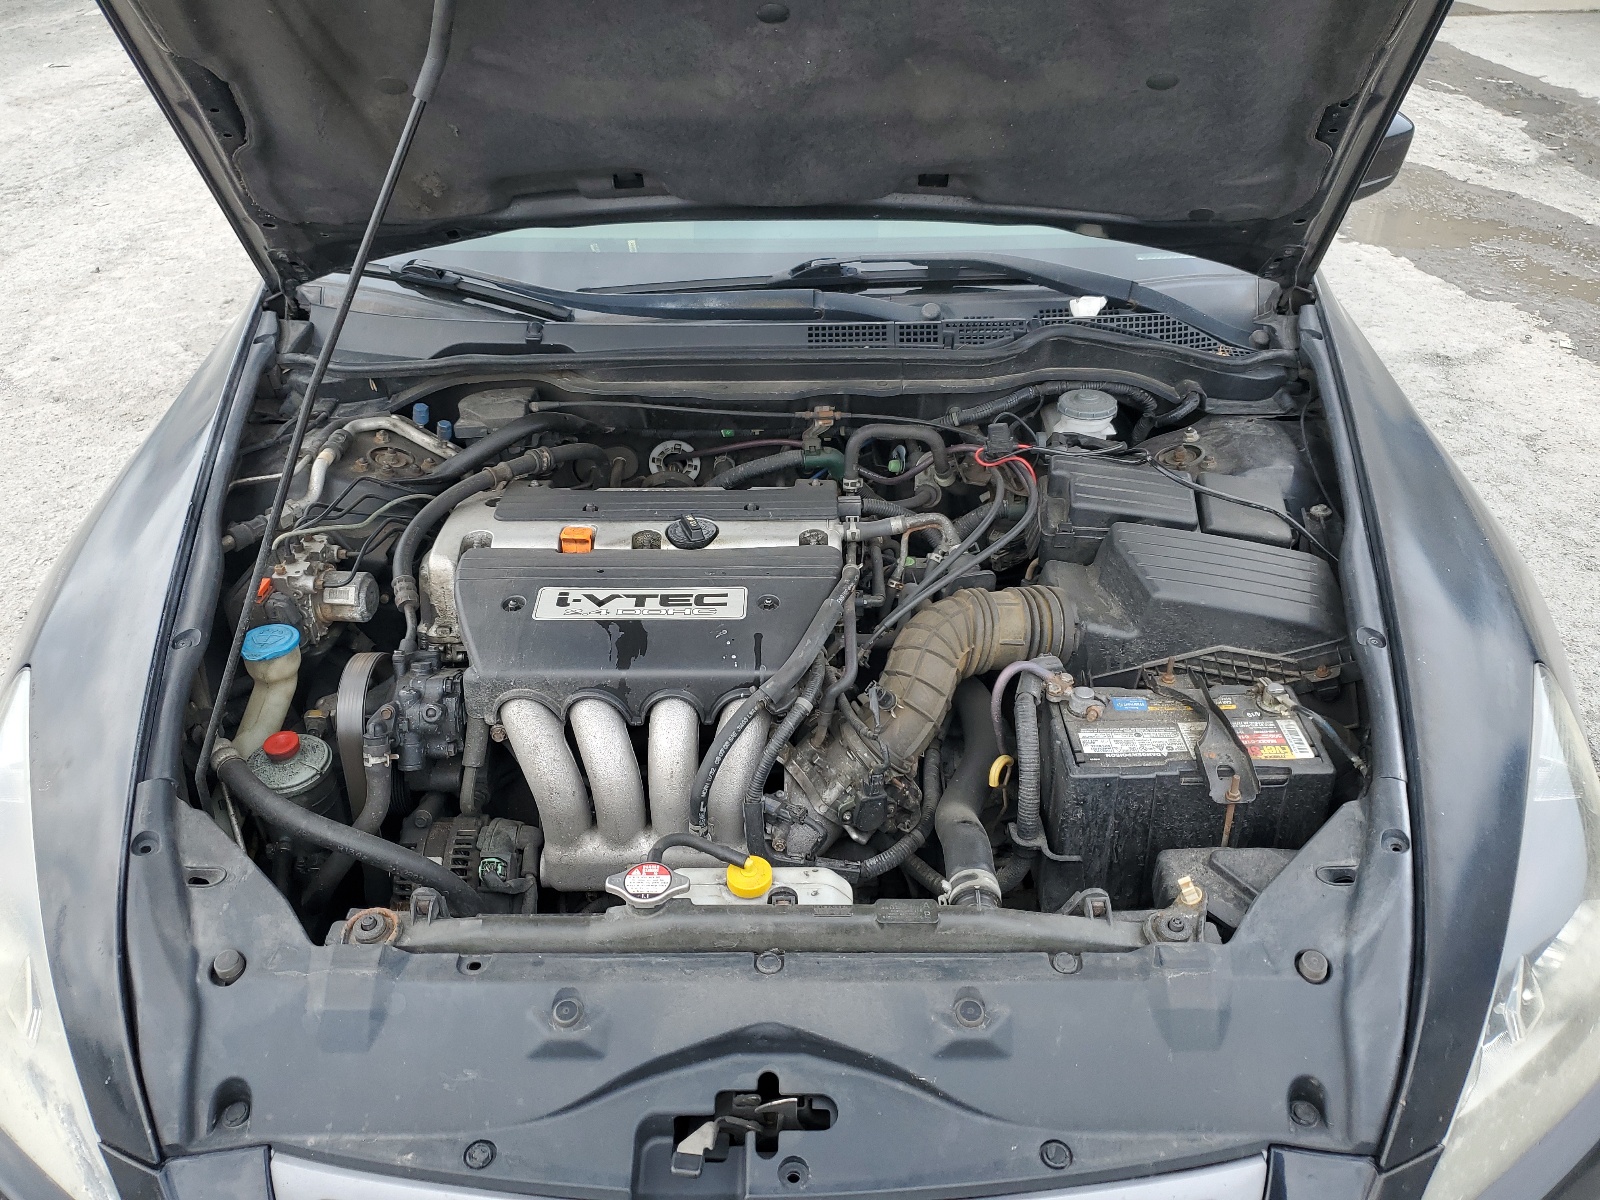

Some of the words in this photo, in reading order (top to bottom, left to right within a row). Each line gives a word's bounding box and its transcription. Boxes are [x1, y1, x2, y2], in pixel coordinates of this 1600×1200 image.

[555, 591, 729, 608] i-VTEC
[563, 608, 610, 616] 2.4
[616, 608, 718, 616] DOHC
